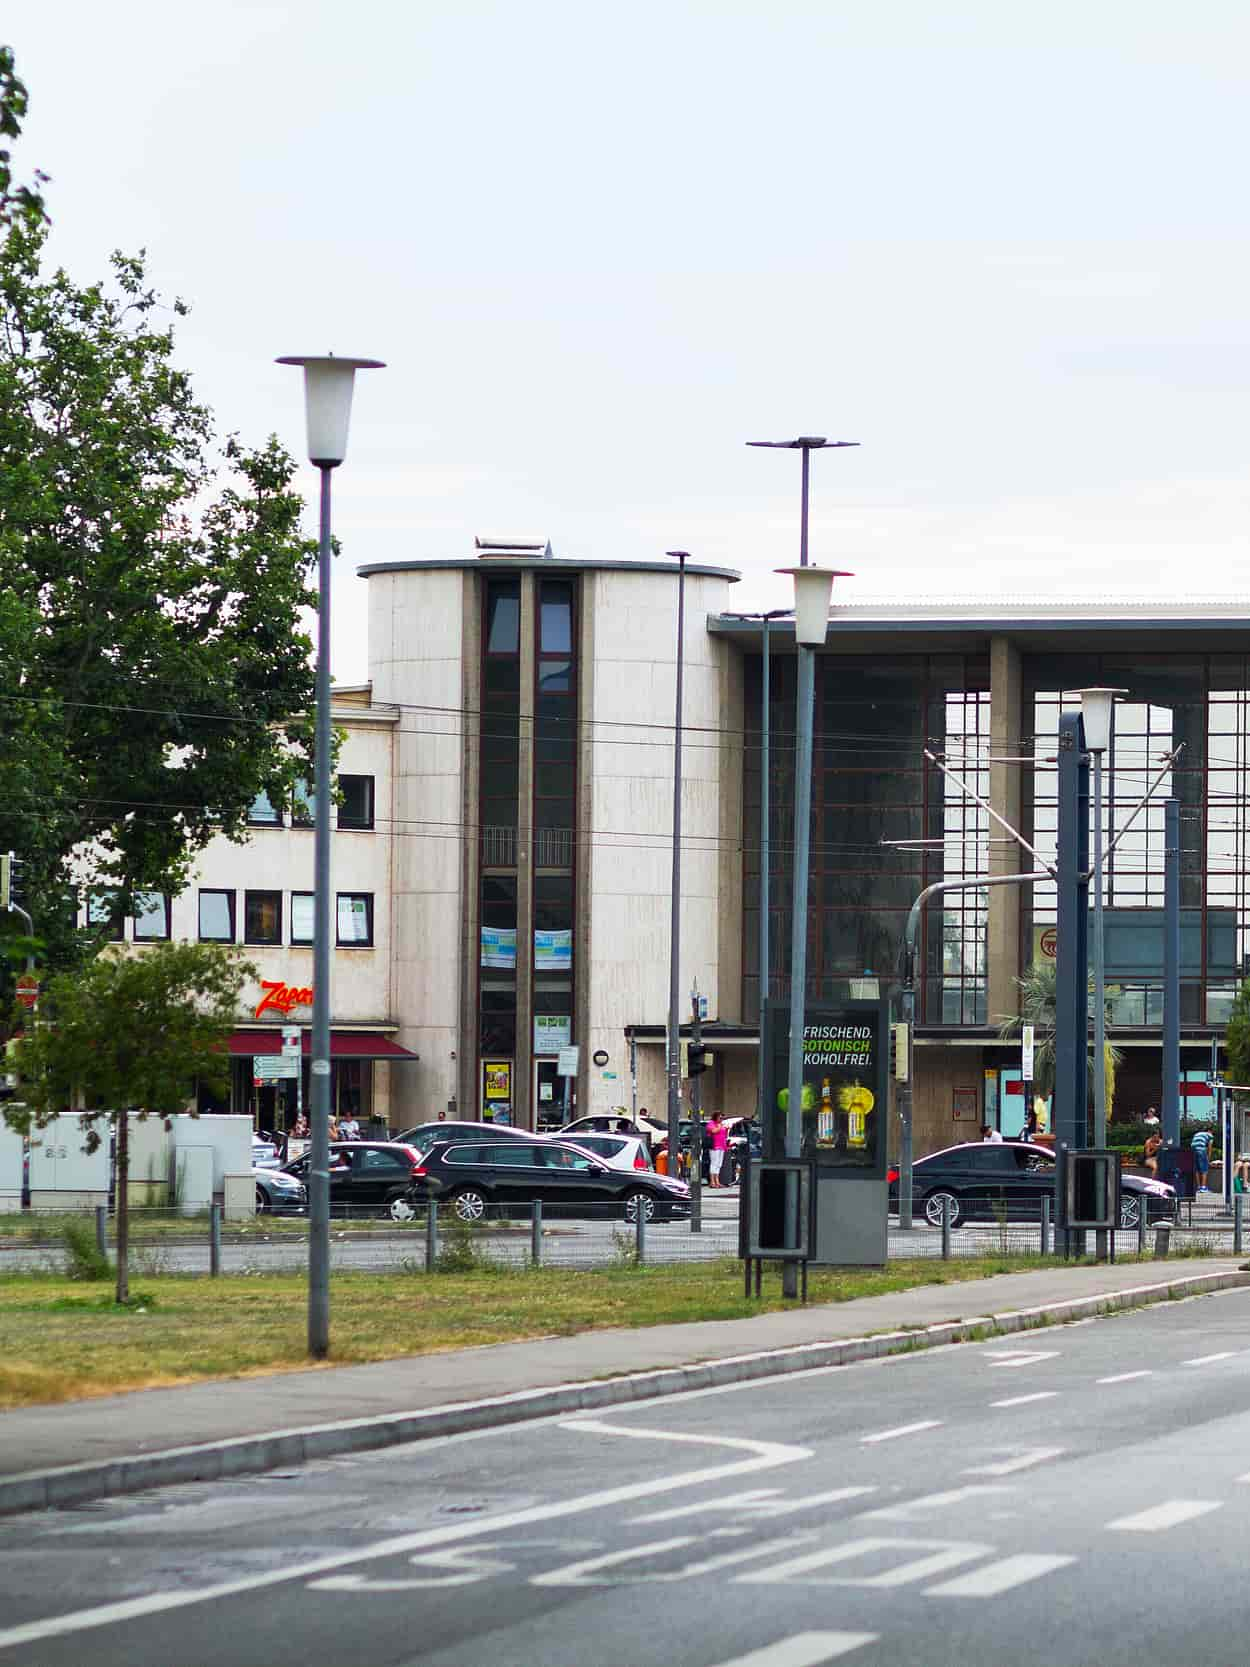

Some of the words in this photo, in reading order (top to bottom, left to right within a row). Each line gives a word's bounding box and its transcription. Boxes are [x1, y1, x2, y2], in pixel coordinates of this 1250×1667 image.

[788, 1026, 873, 1039] FRISCHEND.
[801, 1039, 873, 1052] SOTONISCH.
[803, 1053, 873, 1065] KOHOLFREI.
